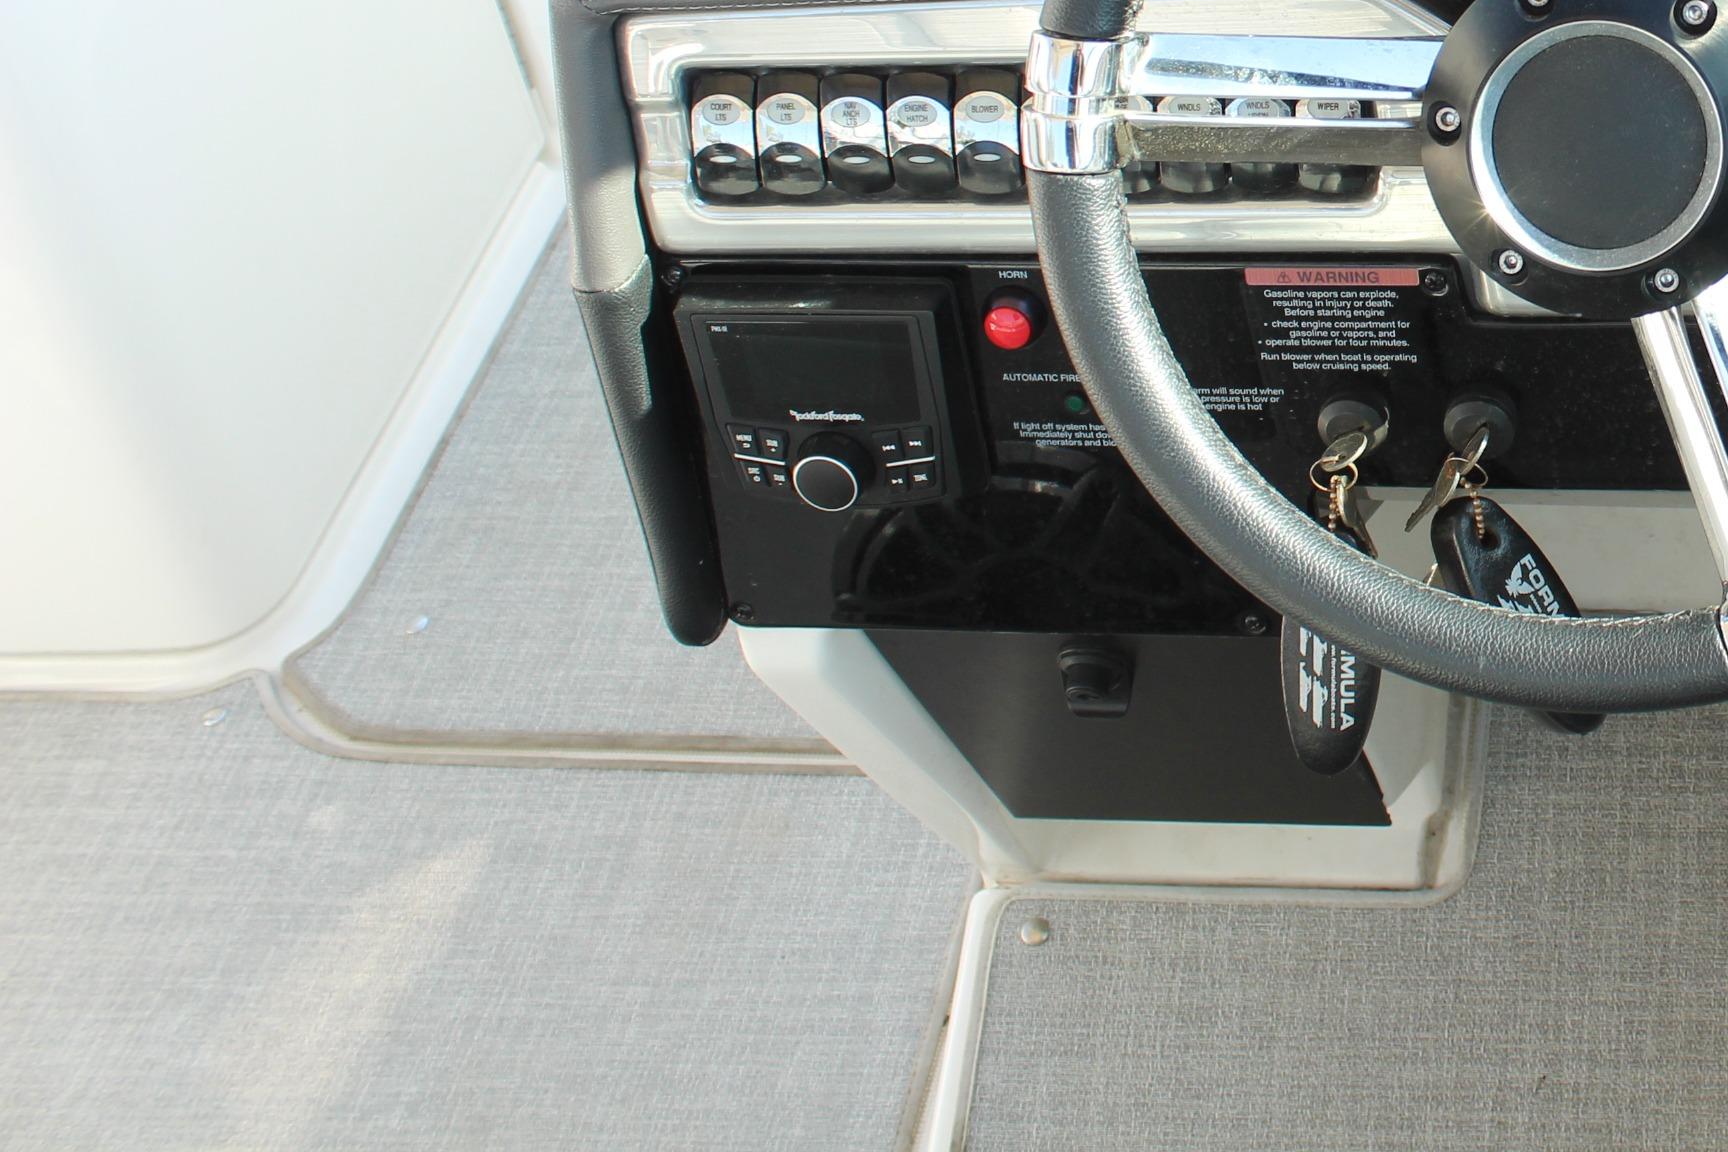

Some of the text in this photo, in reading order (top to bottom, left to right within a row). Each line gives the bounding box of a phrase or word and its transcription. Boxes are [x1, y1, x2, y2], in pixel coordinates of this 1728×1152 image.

[711, 103, 731, 111] COURT
[905, 104, 928, 112] ENGINE
[971, 105, 998, 113] BLOWER
[715, 113, 726, 121] LTS
[781, 113, 791, 121] LTS
[906, 115, 927, 123] HATCH
[1297, 272, 1379, 283] WARNING
[1308, 291, 1338, 299] vapors
[1360, 290, 1399, 299] explode,
[1273, 299, 1312, 309] resulting
[1326, 300, 1351, 309] injury
[1317, 310, 1351, 318] starting
[1354, 310, 1384, 318] engine
[1301, 321, 1332, 330] engine
[1334, 321, 1395, 330] compartment
[1374, 354, 1417, 362] operating
[1322, 363, 1358, 371] cruising
[1361, 363, 1391, 371] speed.
[1003, 373, 1080, 382] AUTOMATIC FIRE
[1229, 387, 1257, 395] sound
[1202, 396, 1239, 404] pressure
[1206, 402, 1235, 411] engine
[1340, 647, 1355, 731] MULA
